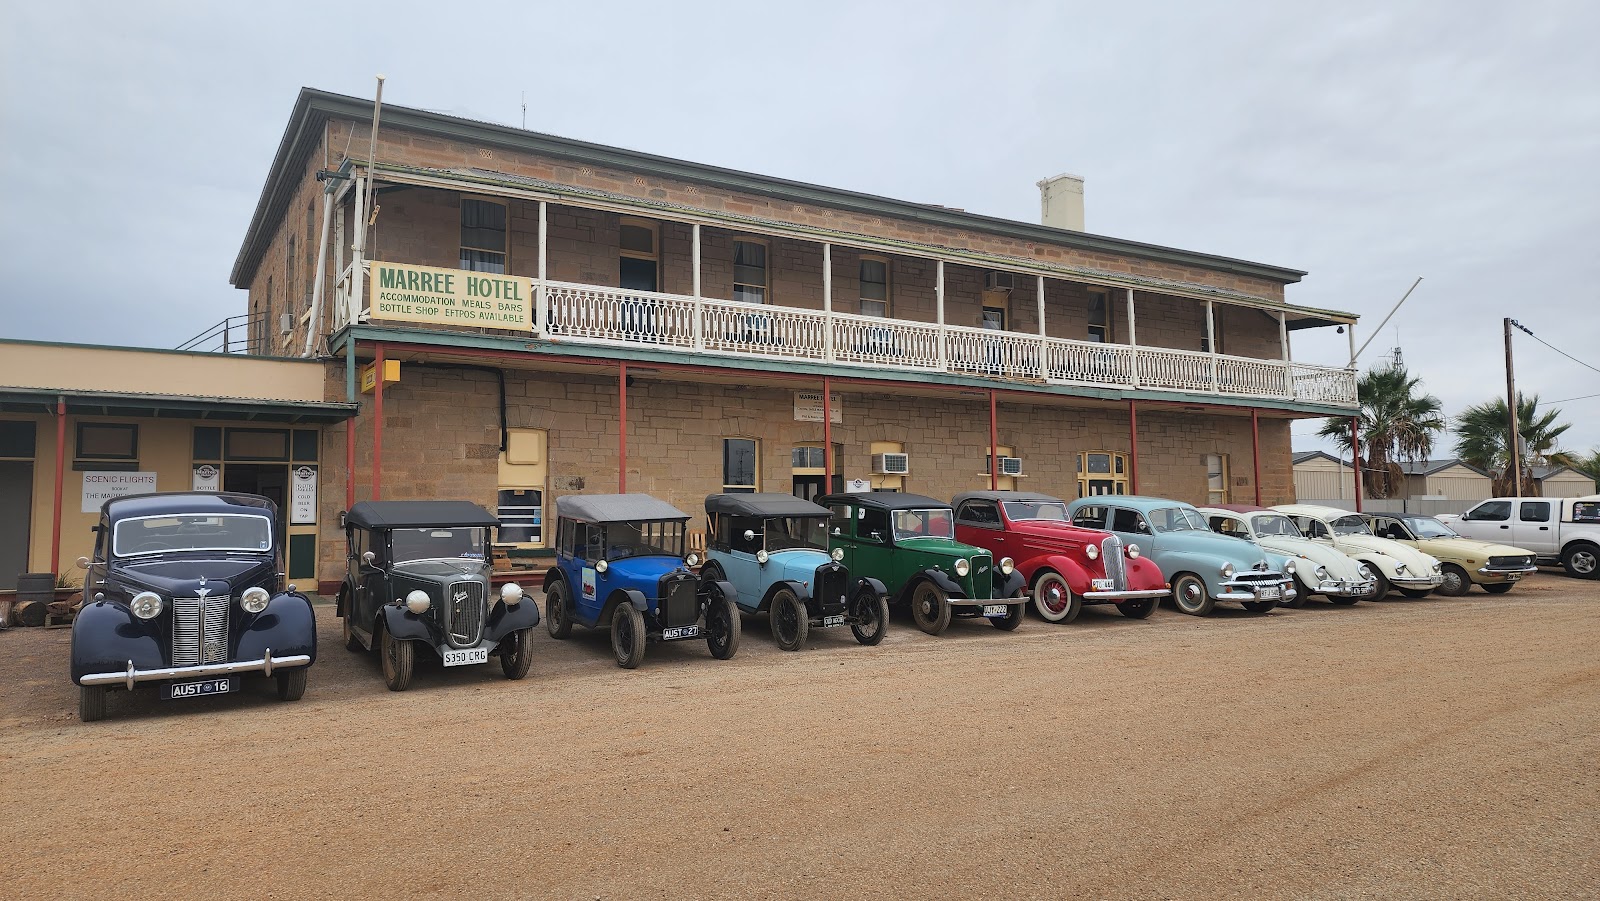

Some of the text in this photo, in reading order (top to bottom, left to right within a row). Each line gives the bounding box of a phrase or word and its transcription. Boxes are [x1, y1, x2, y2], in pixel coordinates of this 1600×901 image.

[380, 268, 523, 300] MARREE HOTEL
[380, 292, 523, 312] ACCOMMODATION MEALS BARS
[380, 303, 524, 323] BOTTLE SHOP EFTPOS AVAILABLE
[296, 484, 314, 492] BAR
[664, 628, 682, 638] AUST
[174, 681, 227, 696] AUST 16
